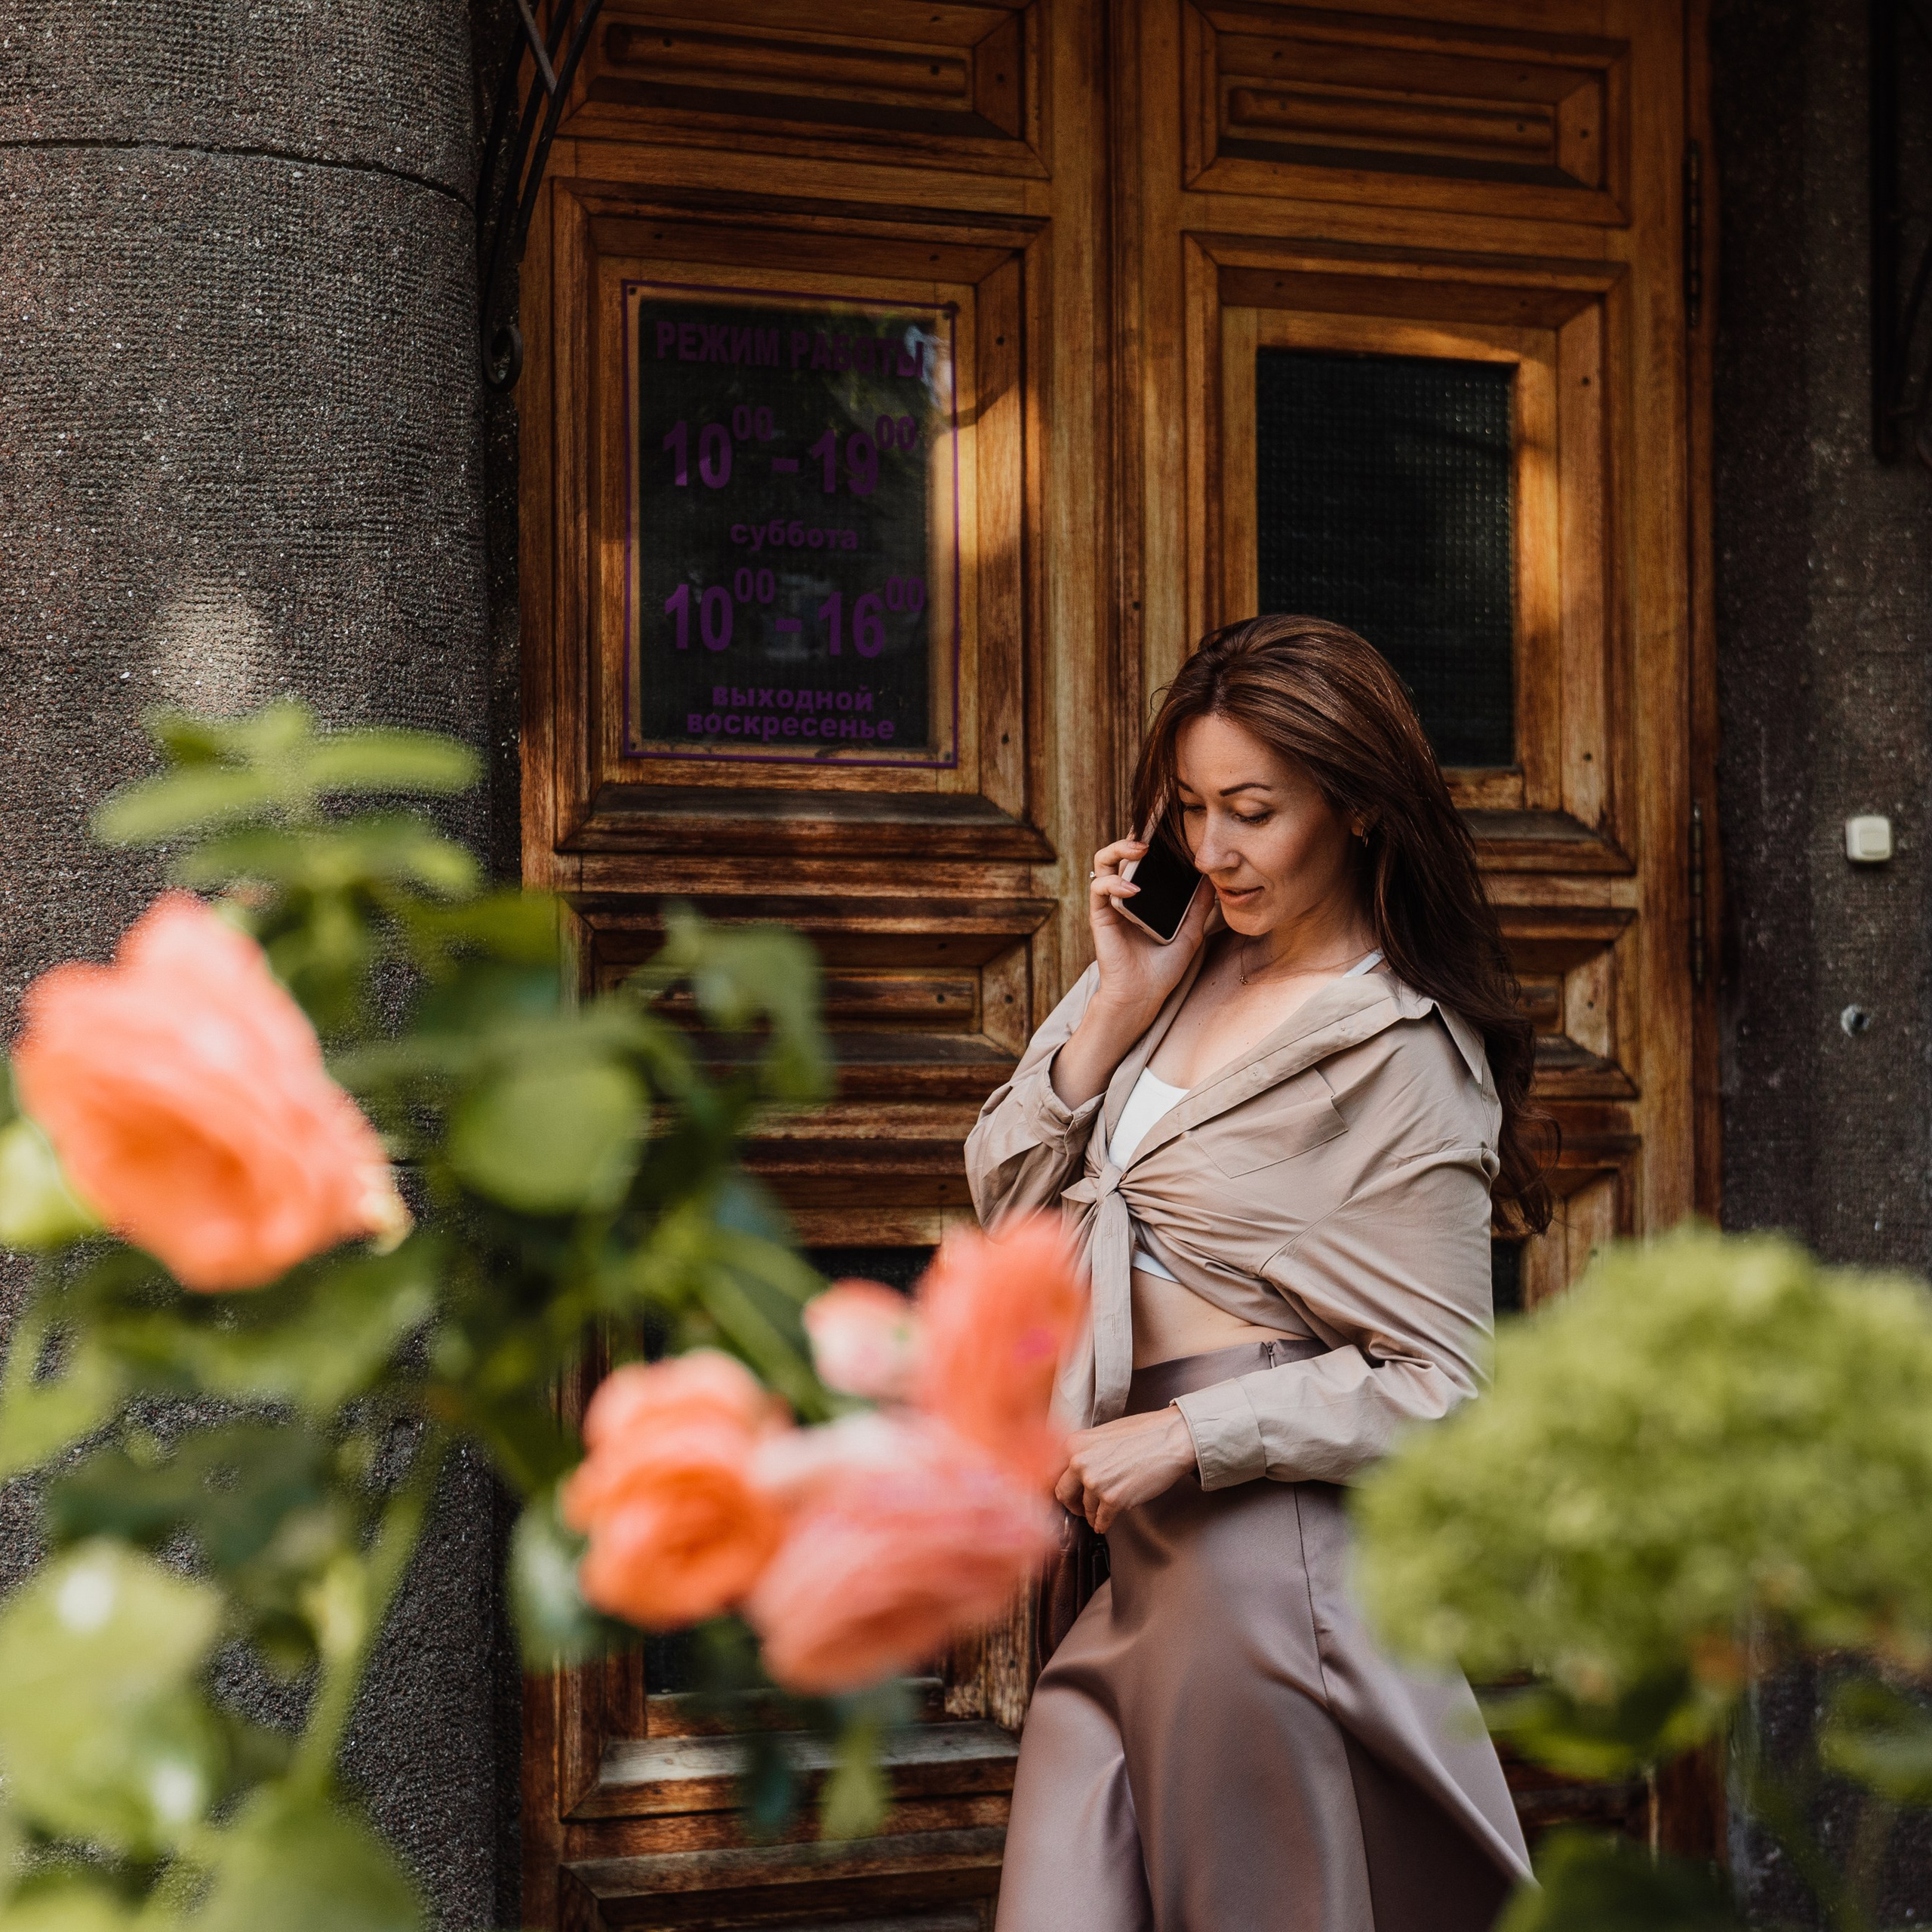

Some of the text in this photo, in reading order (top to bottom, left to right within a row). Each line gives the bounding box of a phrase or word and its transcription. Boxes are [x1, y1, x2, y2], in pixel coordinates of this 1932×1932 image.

[656, 321, 924, 378] РЕЖИМ РАБОТЫ
[730, 520, 858, 552] суббота
[712, 685, 873, 714] выходной
[687, 712, 895, 741] воскресенье
